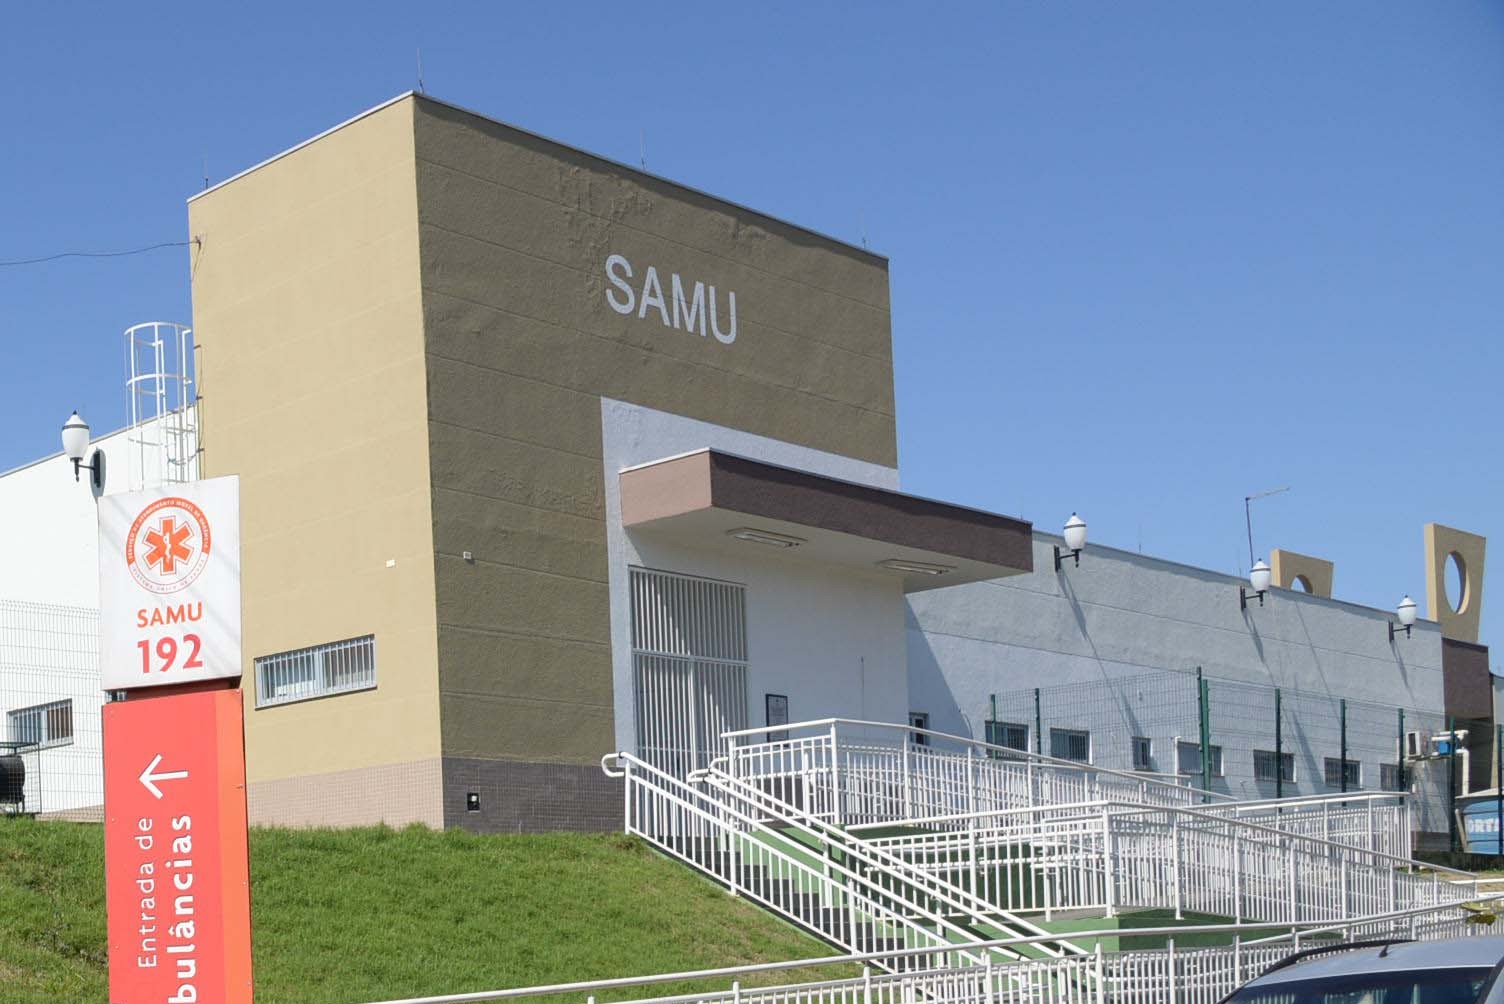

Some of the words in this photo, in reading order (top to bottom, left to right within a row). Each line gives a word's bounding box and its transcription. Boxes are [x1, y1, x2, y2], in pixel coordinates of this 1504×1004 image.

[605, 254, 737, 344] SAMU
[136, 602, 203, 628] SAMU
[137, 634, 203, 674] 192
[135, 818, 153, 850] de
[135, 862, 157, 968] Entrada
